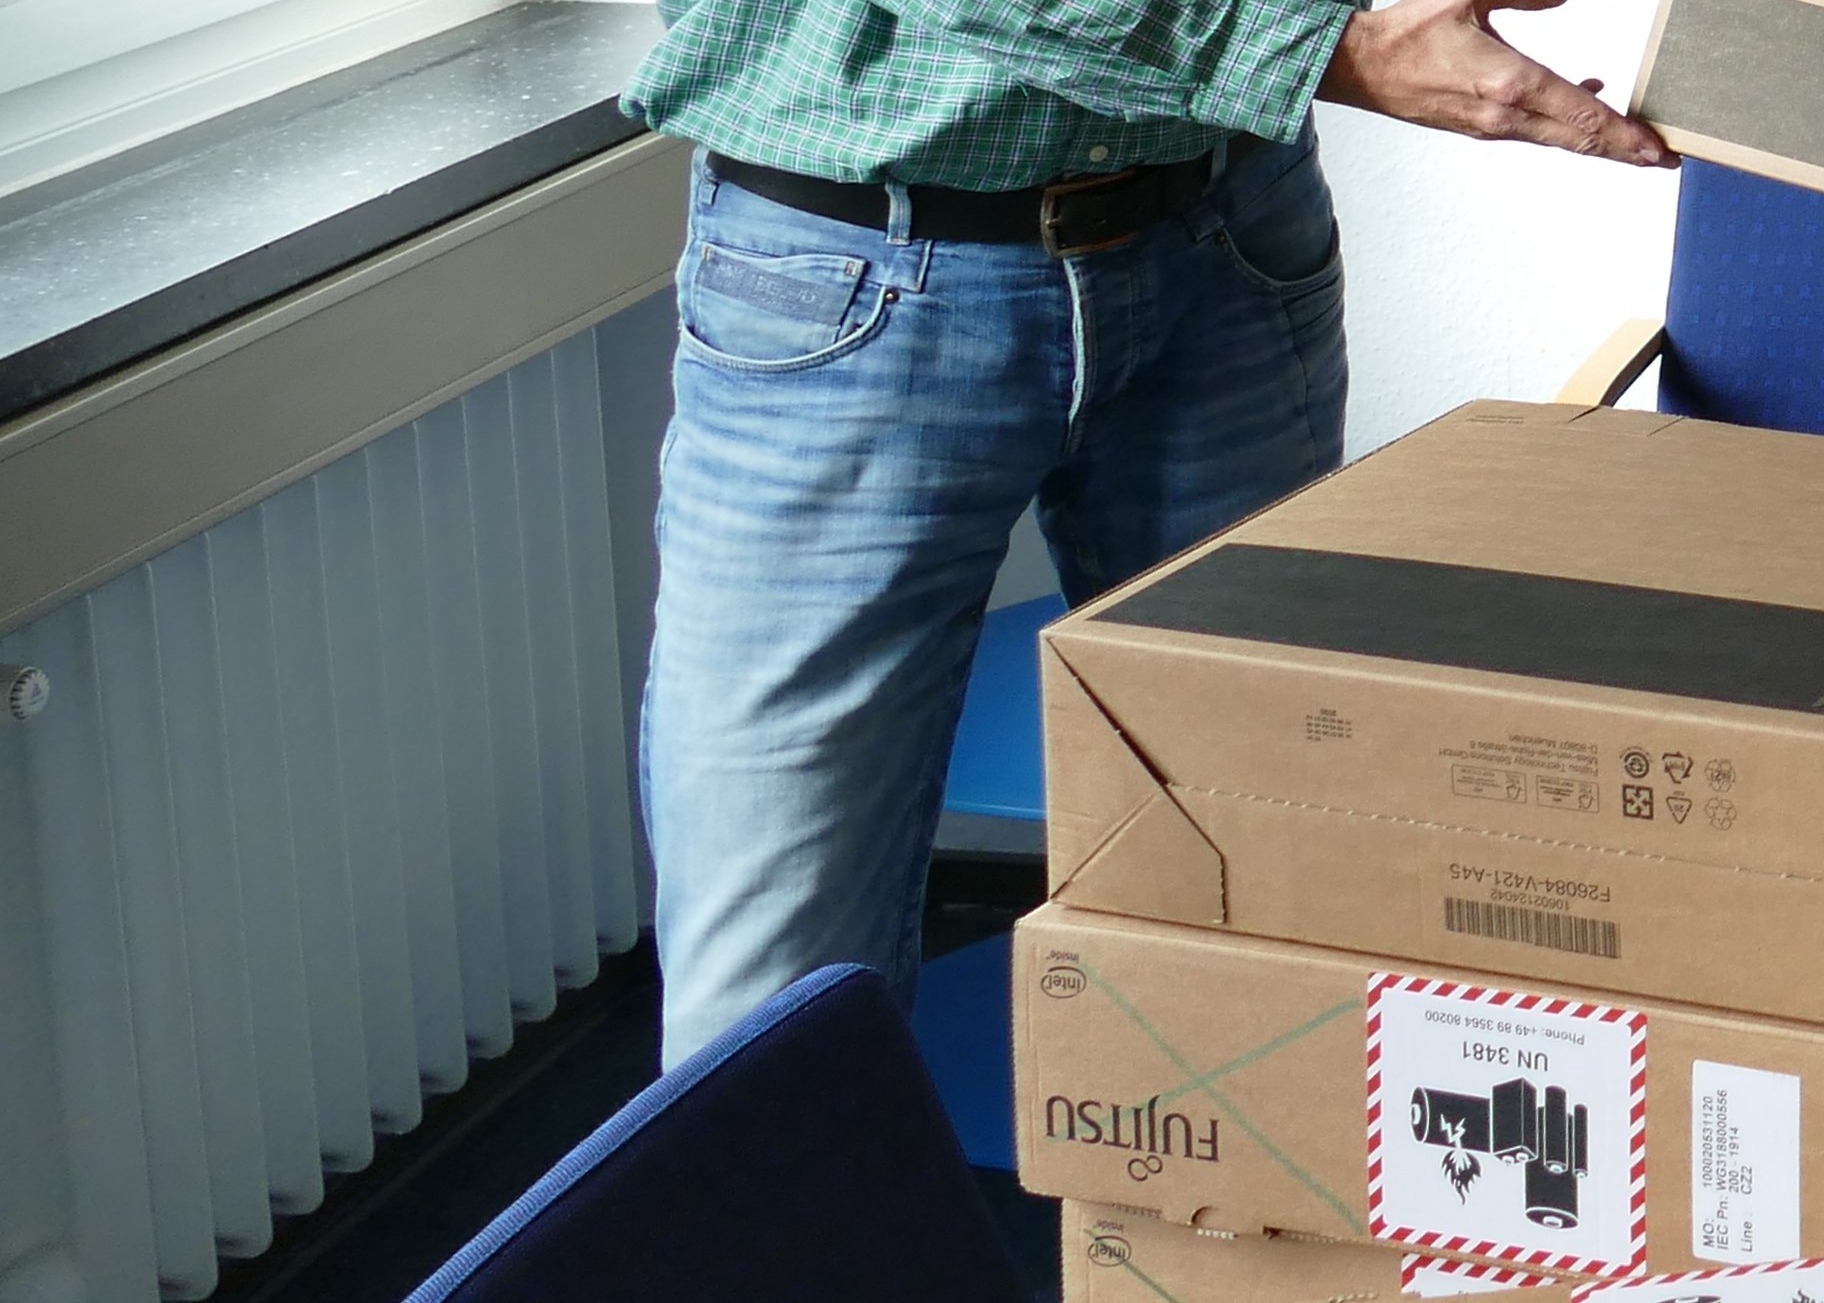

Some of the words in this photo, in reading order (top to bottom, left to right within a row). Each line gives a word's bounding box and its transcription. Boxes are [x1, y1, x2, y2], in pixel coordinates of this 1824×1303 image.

[1513, 757, 1566, 773] Technology
[1448, 861, 1612, 903] F26084-V421-A45
[1489, 887, 1571, 912] 10602124042
[1424, 1010, 1462, 1029] 80200
[1463, 1014, 1495, 1033] 3564
[1496, 1020, 1512, 1034] 89
[1514, 1022, 1540, 1038] +49
[1541, 1026, 1586, 1046] Phone:
[1460, 1040, 1510, 1066] 3481
[1516, 1048, 1550, 1073] UN
[1044, 1094, 1221, 1179] FUJITSU
[1702, 1096, 1714, 1189] 100020531120
[1728, 1126, 1740, 1157] 1914
[1728, 1169, 1740, 1193] 200
[1741, 1165, 1753, 1195] CZ2
[1717, 1195, 1729, 1220] Pn:
[1702, 1218, 1716, 1248] MO:
[1717, 1224, 1729, 1250] IEC
[1741, 1221, 1753, 1253] Line
